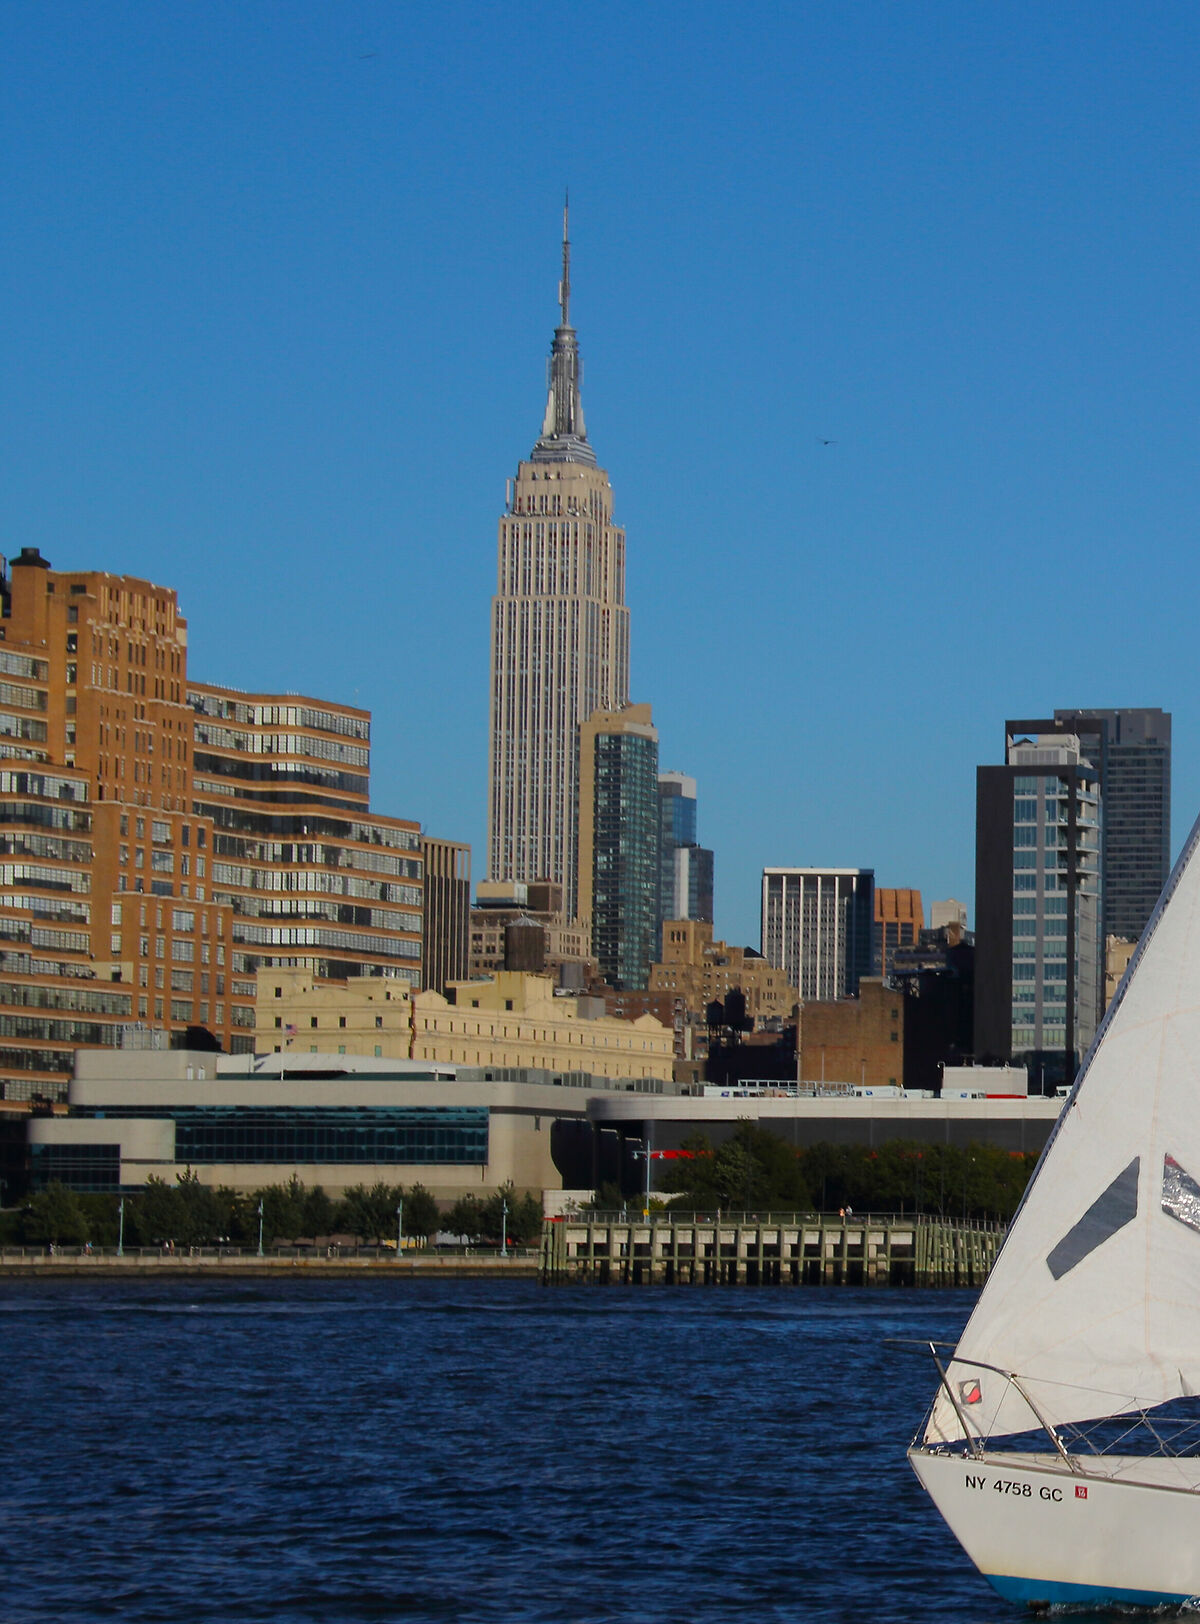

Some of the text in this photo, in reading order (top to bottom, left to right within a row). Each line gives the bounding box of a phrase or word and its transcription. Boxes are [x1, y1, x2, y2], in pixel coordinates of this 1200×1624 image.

[965, 1475, 1063, 1502] NY 4758 GC
